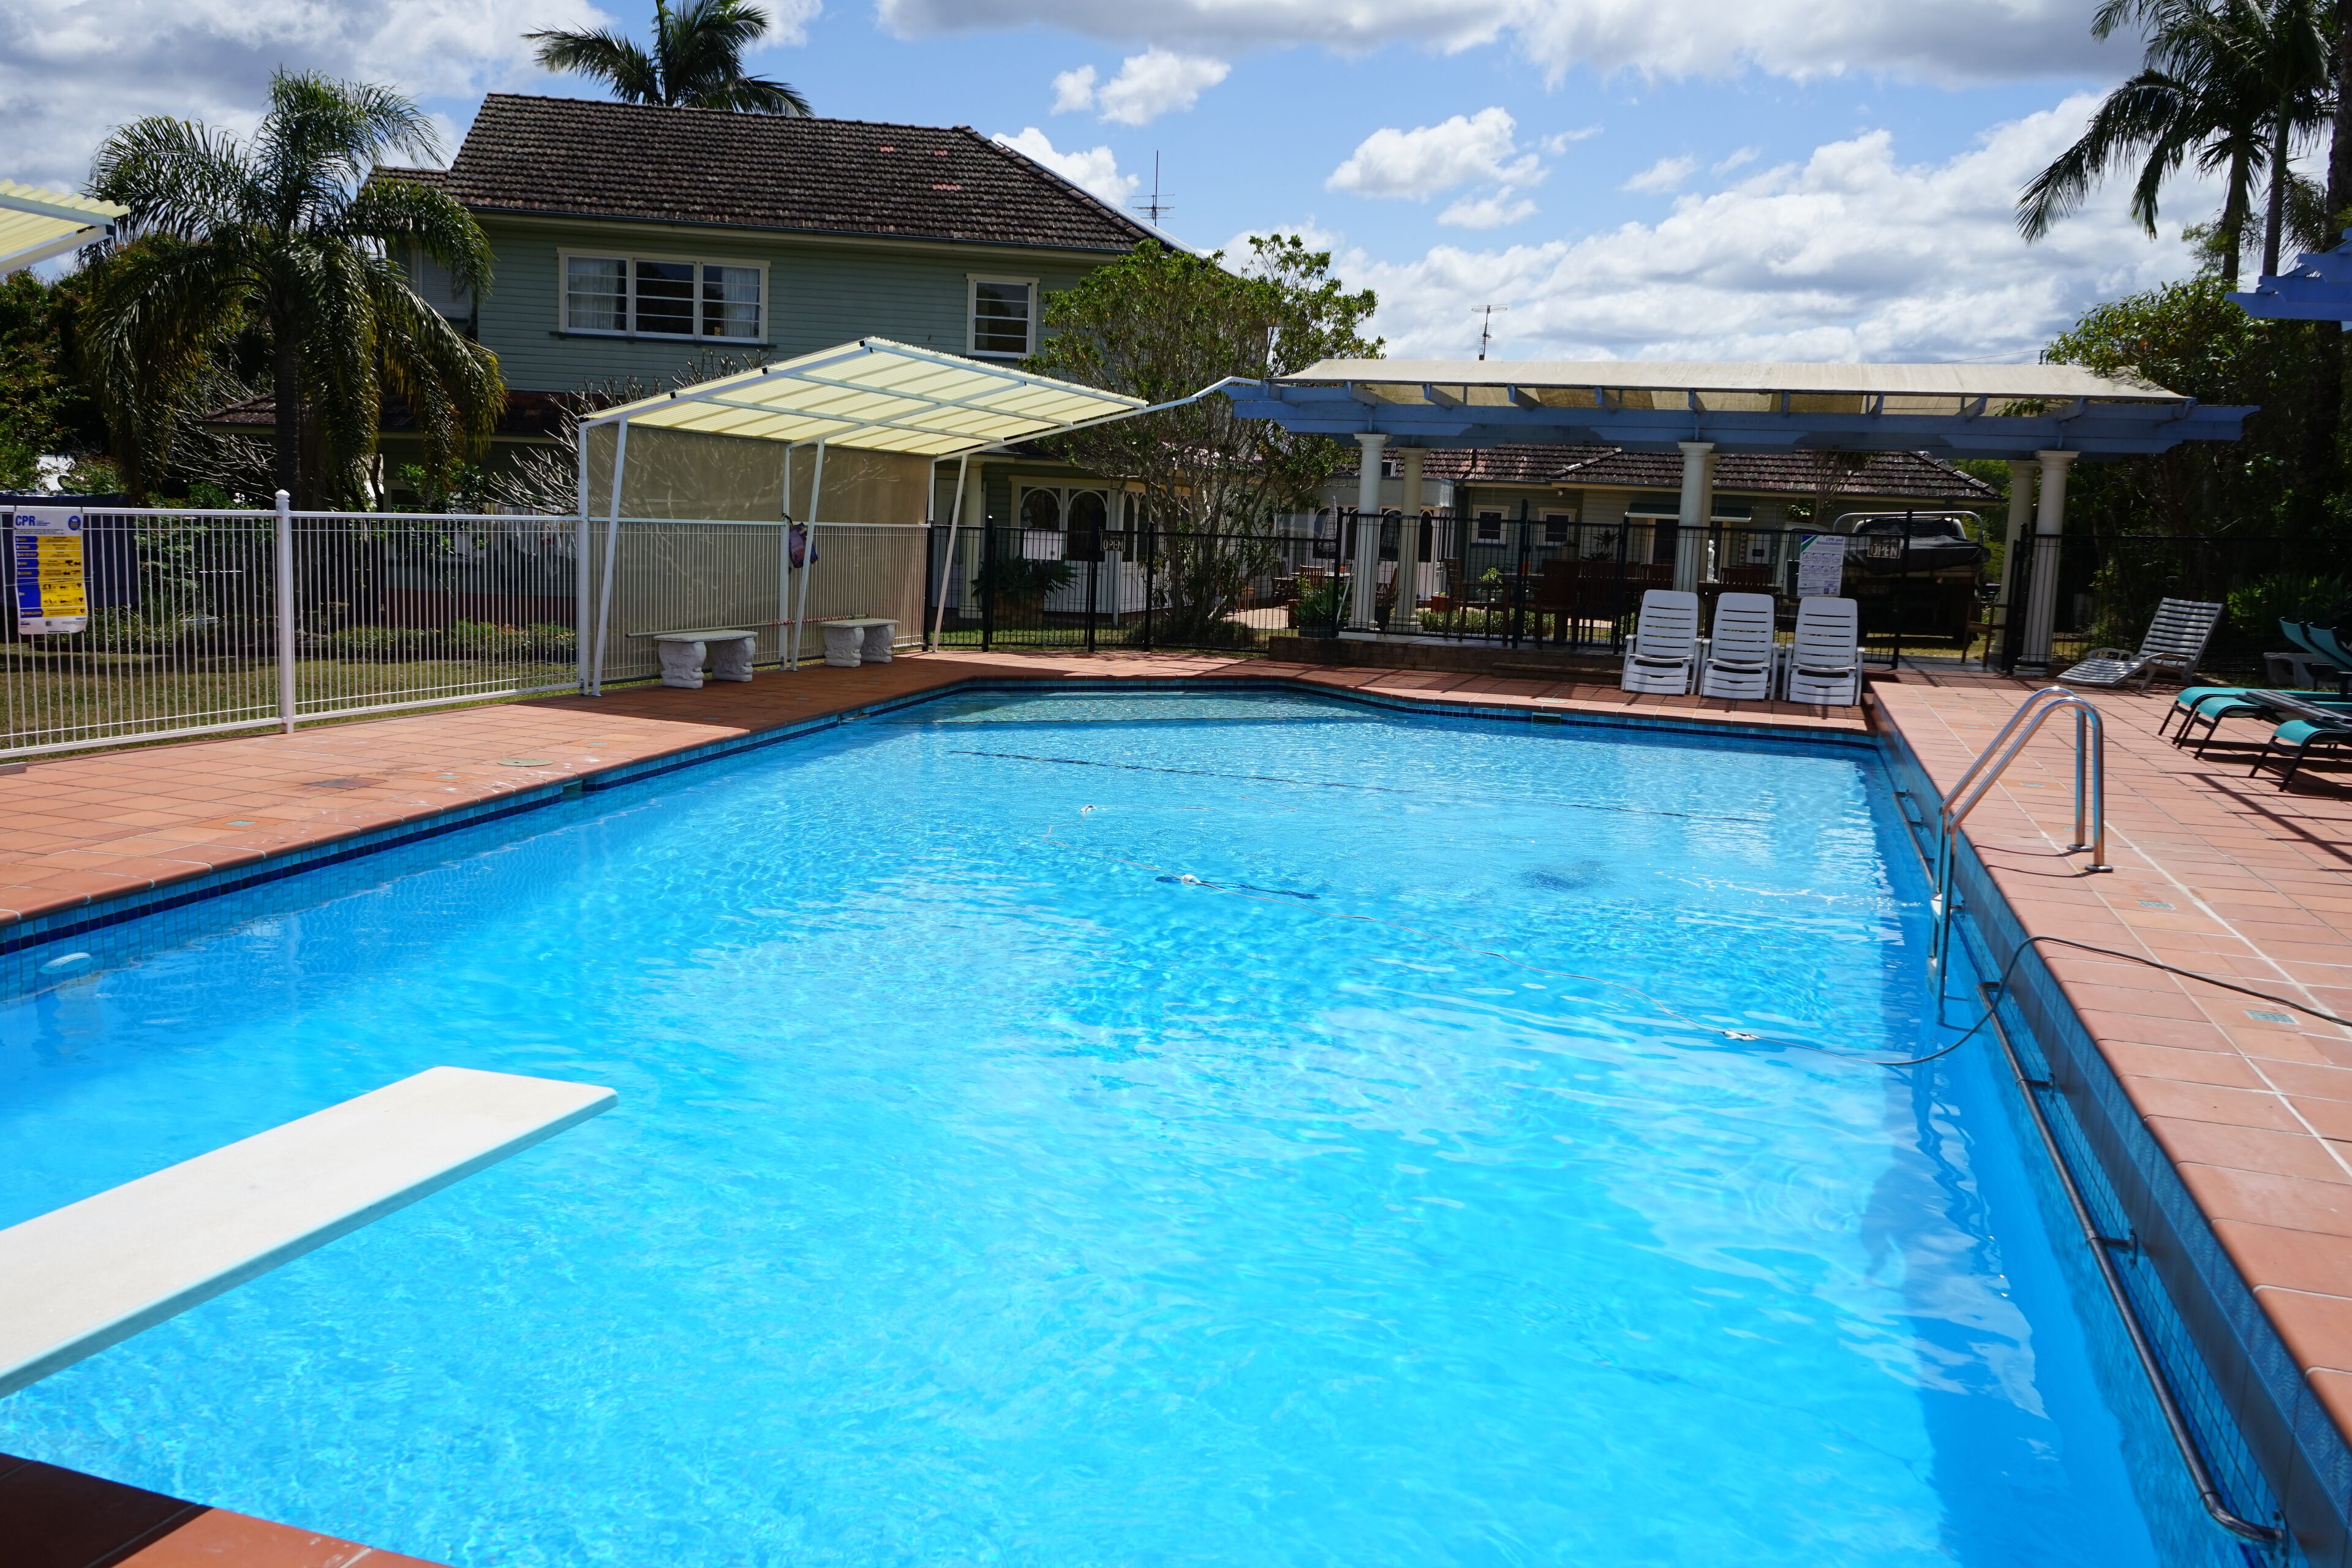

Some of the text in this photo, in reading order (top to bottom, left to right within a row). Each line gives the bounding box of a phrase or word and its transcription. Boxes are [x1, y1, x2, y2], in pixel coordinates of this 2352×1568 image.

[15, 515, 36, 526] CPR
[1103, 539, 1123, 550] OPEN
[1871, 543, 1898, 556] OPEN
